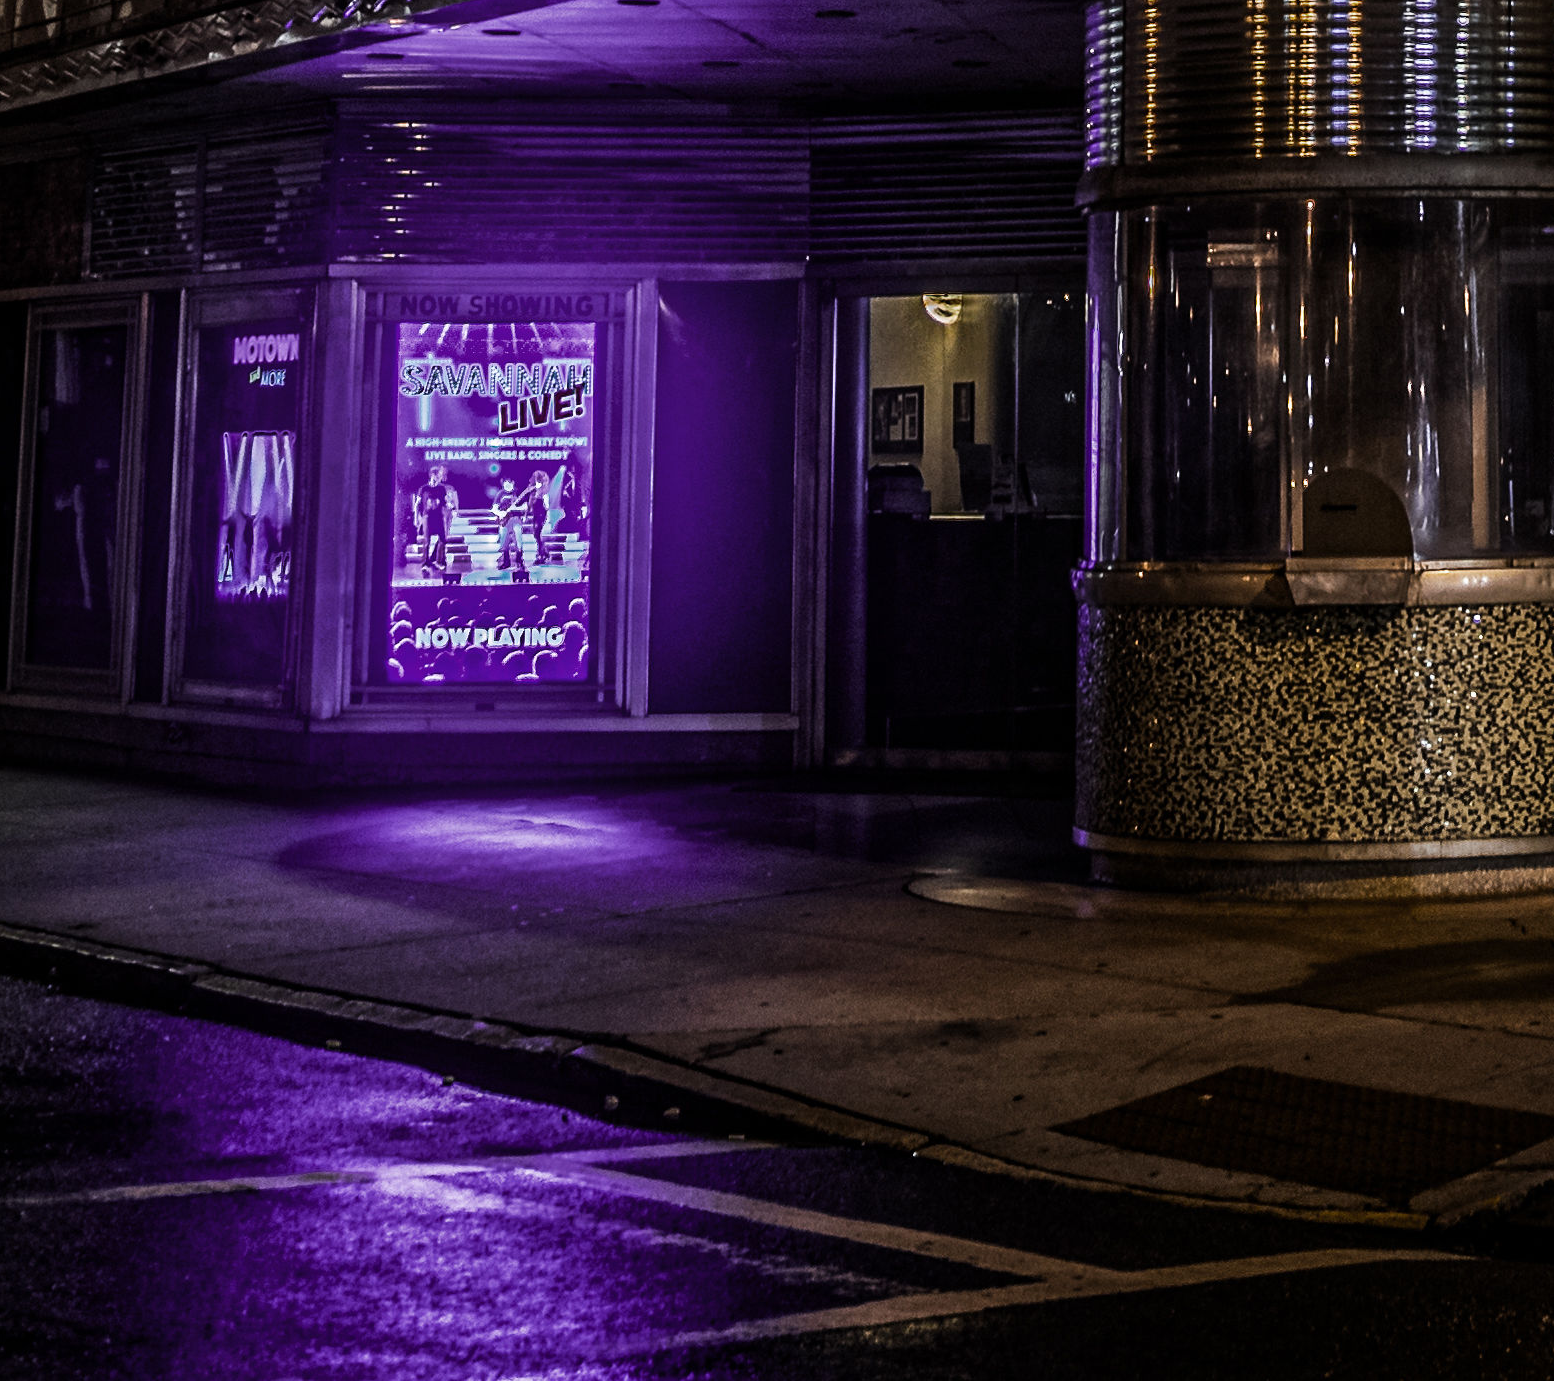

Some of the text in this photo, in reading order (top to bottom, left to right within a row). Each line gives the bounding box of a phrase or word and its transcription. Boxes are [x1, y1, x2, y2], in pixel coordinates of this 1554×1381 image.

[400, 294, 594, 317] NOW SHOWING
[233, 333, 300, 364] MOTOWN
[261, 369, 287, 387] MORE
[400, 364, 592, 396] SAVANNAH
[499, 382, 586, 434] LIVE!
[425, 450, 445, 460] LIVE
[527, 450, 570, 460] COMEDY
[415, 626, 563, 649] NOW PLAYING
